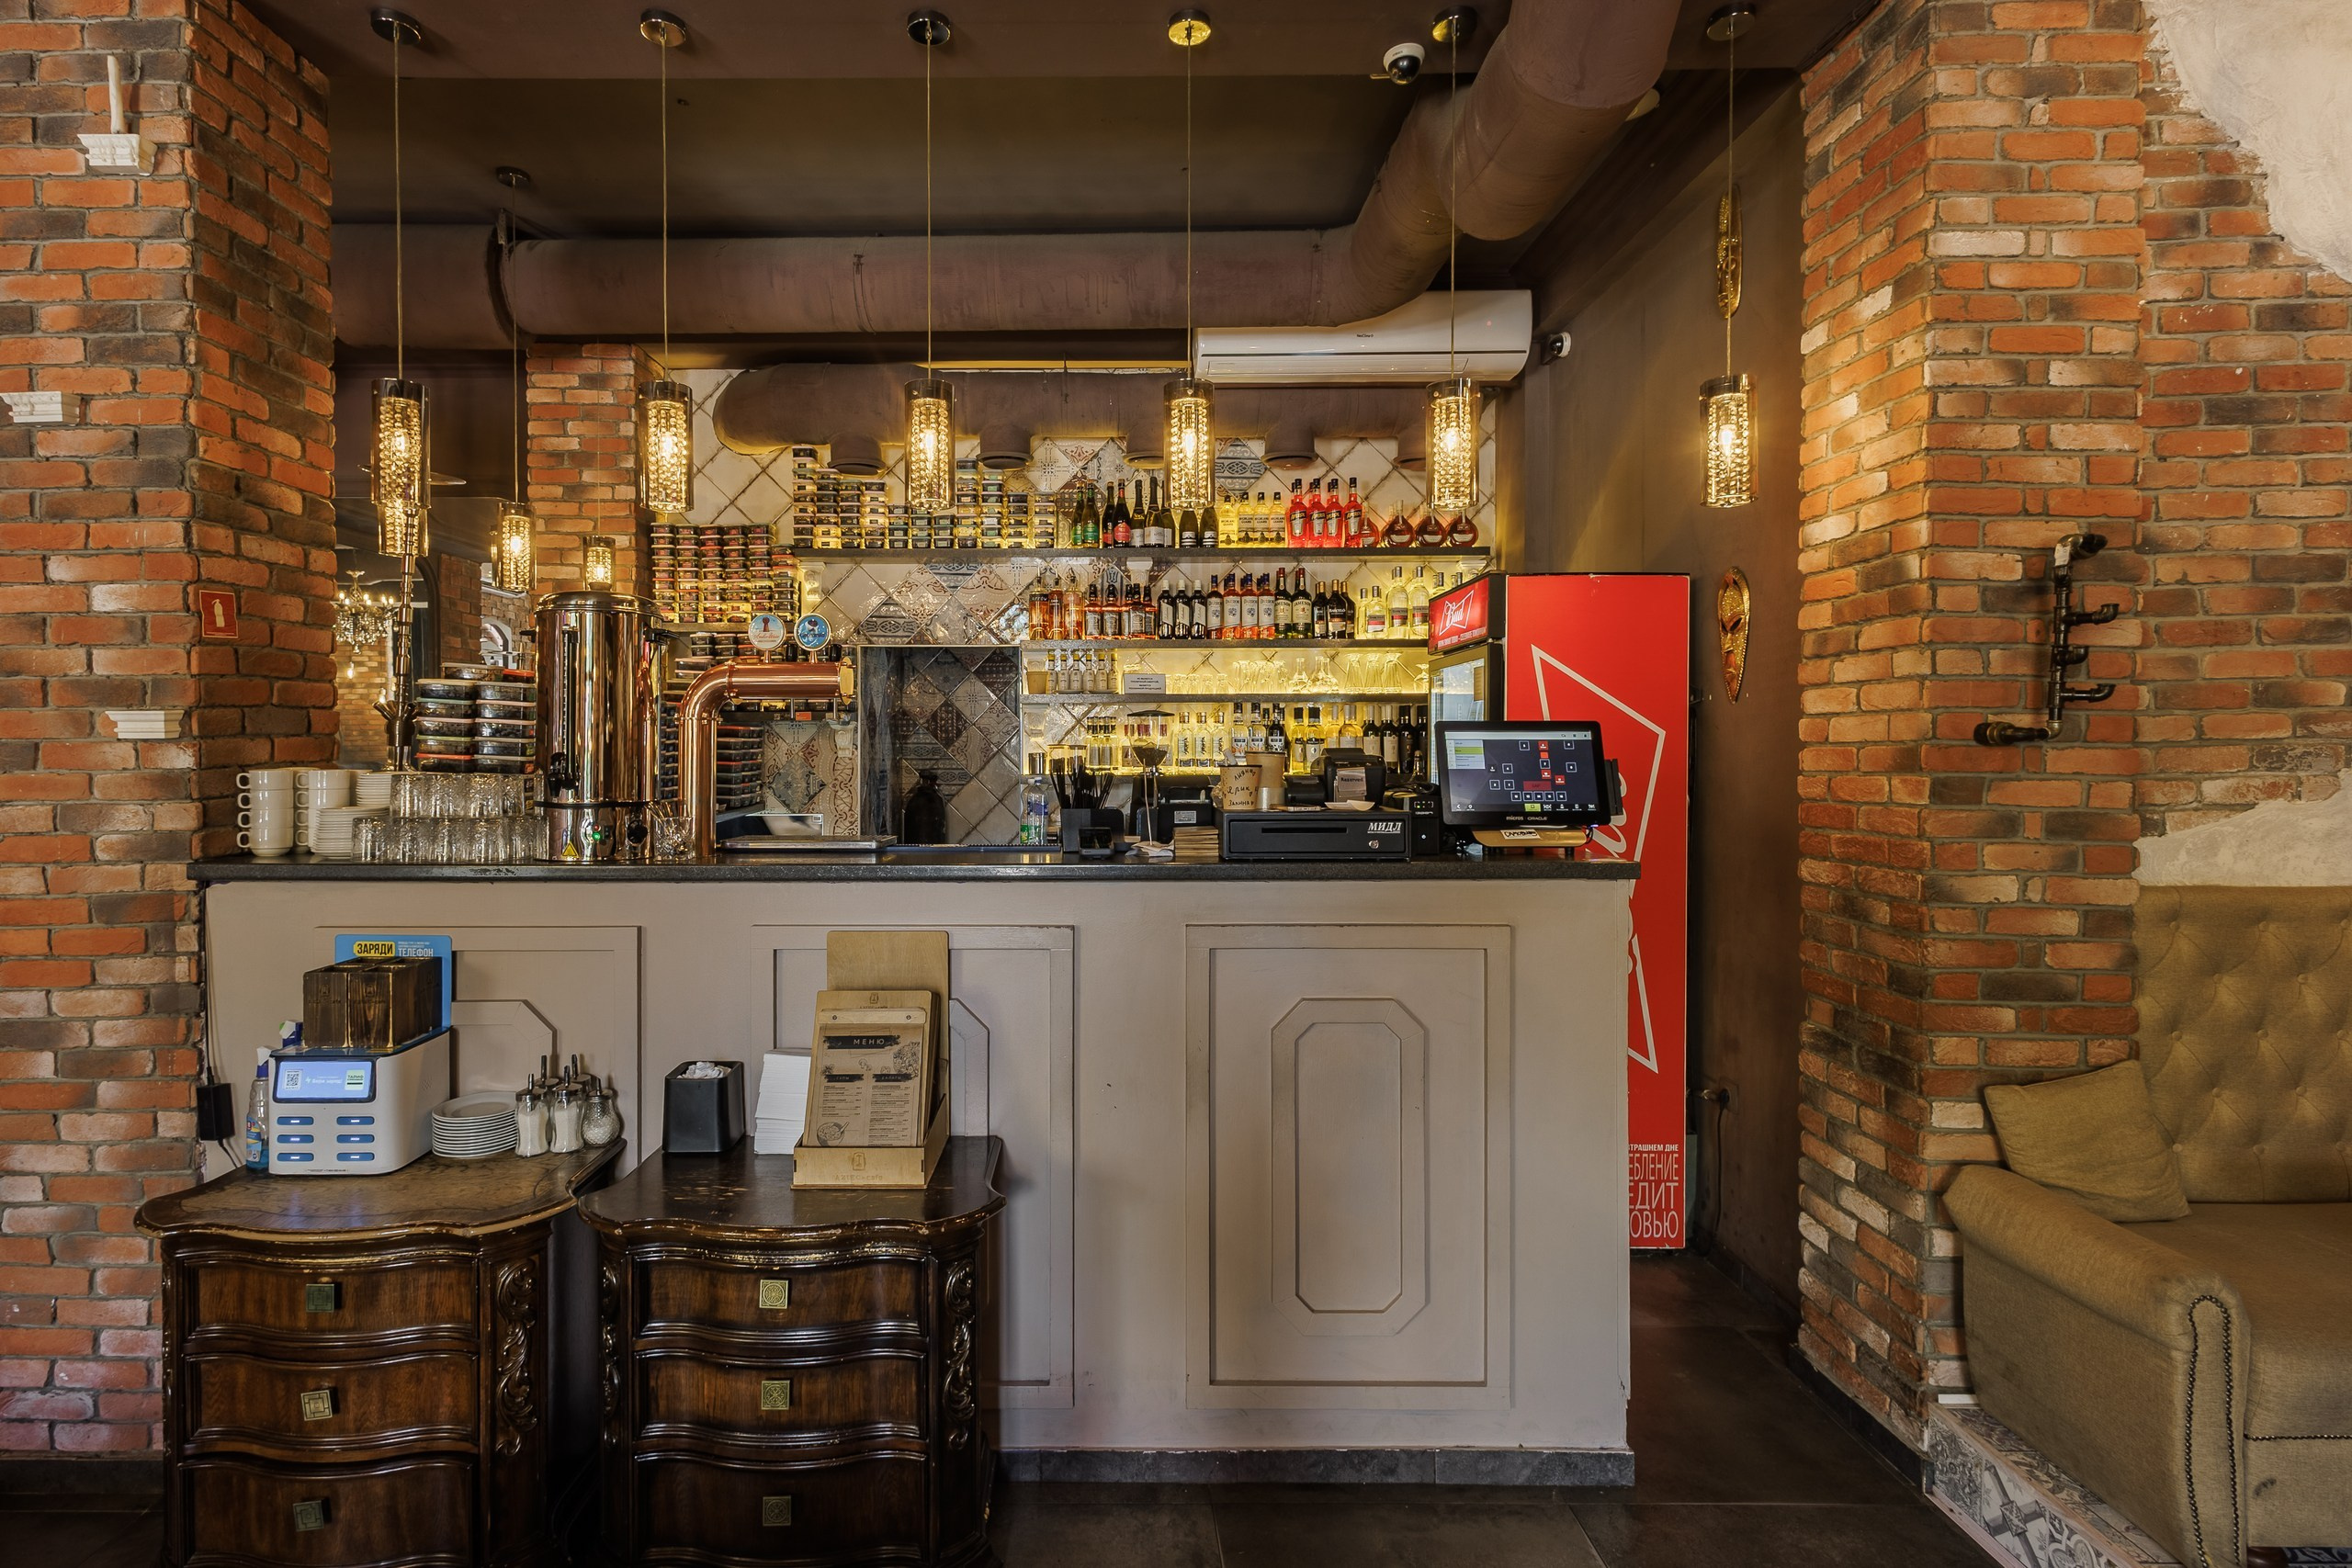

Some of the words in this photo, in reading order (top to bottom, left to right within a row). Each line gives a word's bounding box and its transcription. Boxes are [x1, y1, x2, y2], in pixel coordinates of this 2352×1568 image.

[1368, 822, 1402, 832] МИДЛ
[356, 942, 393, 955] ЗАРЯДИ
[398, 948, 434, 957] ТЕЛЕФОН
[1665, 1144, 1679, 1152] ДНЕ
[1630, 1211, 1679, 1238] ОВЬЮ
